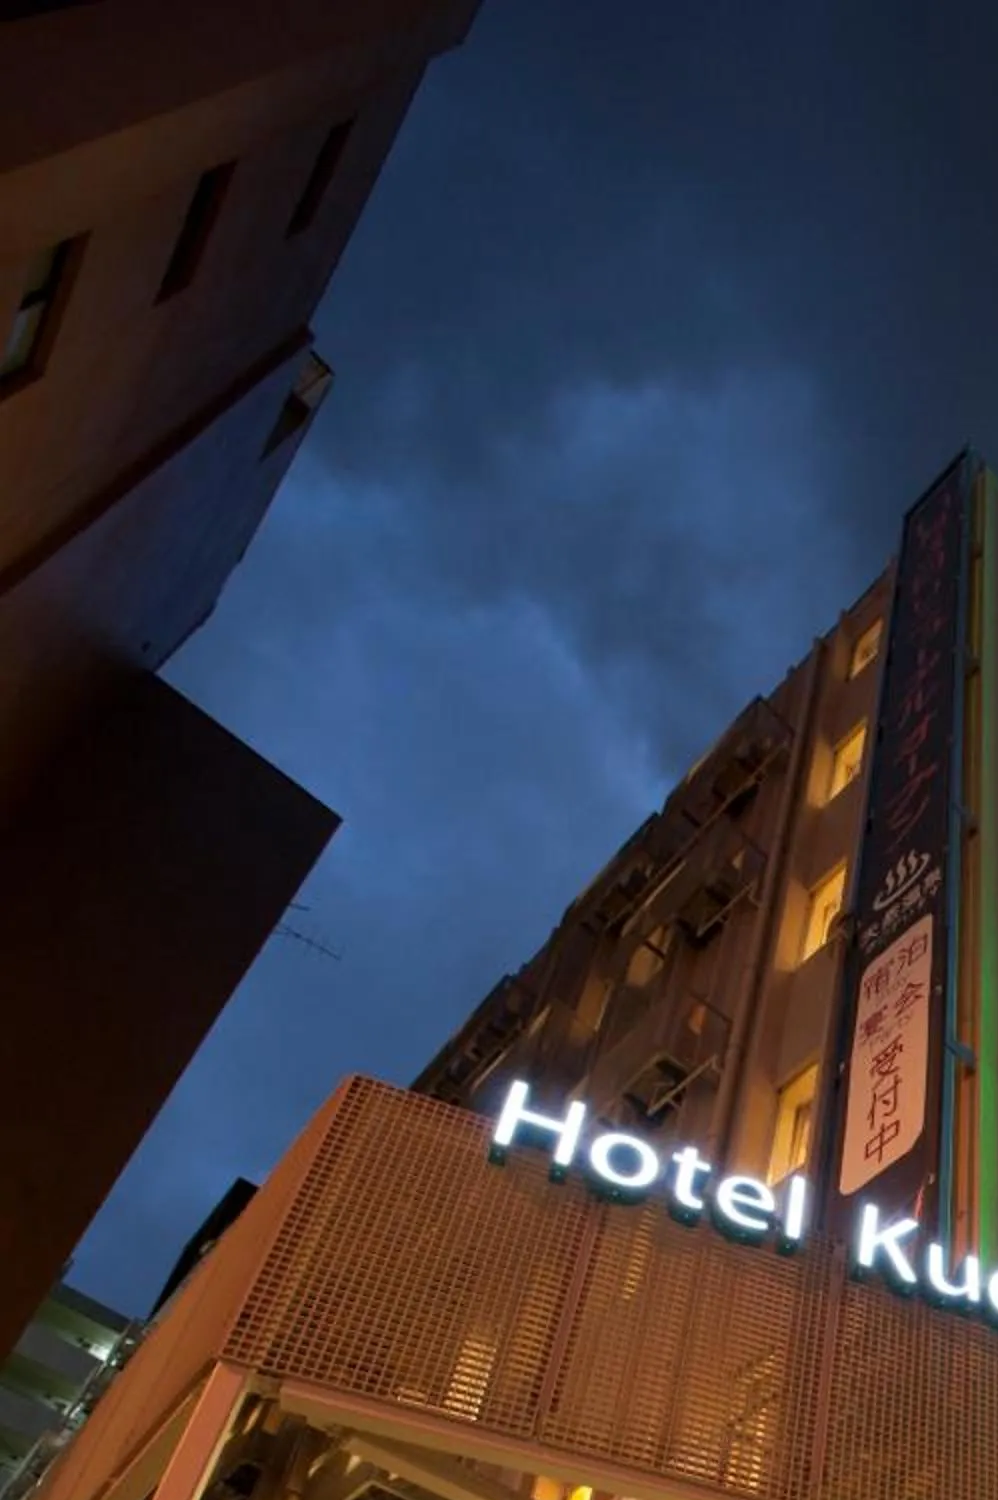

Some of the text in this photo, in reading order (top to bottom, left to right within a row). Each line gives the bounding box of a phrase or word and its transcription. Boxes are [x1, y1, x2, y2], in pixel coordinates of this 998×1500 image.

[493, 1078, 807, 1240] Hotel
[864, 1034, 904, 1164] 受付中
